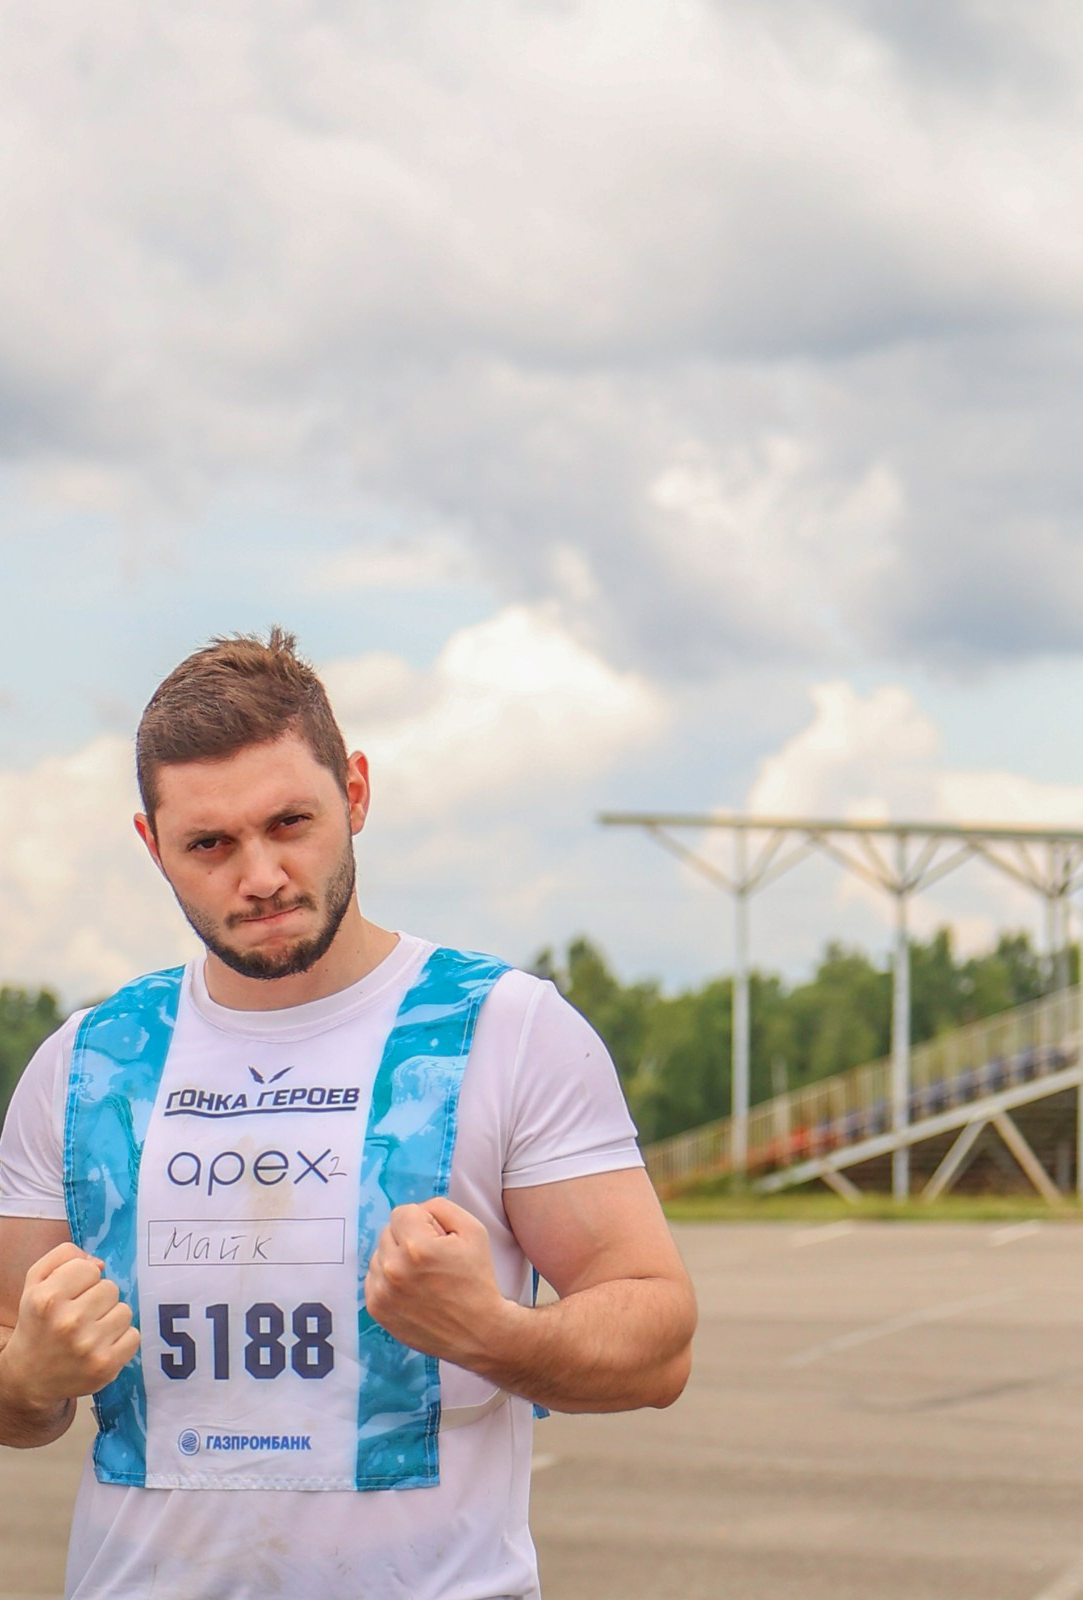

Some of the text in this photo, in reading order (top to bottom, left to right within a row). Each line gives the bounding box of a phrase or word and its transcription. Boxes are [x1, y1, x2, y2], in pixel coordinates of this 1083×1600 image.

[165, 1087, 361, 1112] ГОНКА ГЕРОЕВ
[163, 1226, 273, 1261] Майк
[158, 1302, 335, 1380] 5188
[205, 1434, 312, 1450] ГАЗПРОМБАНК
